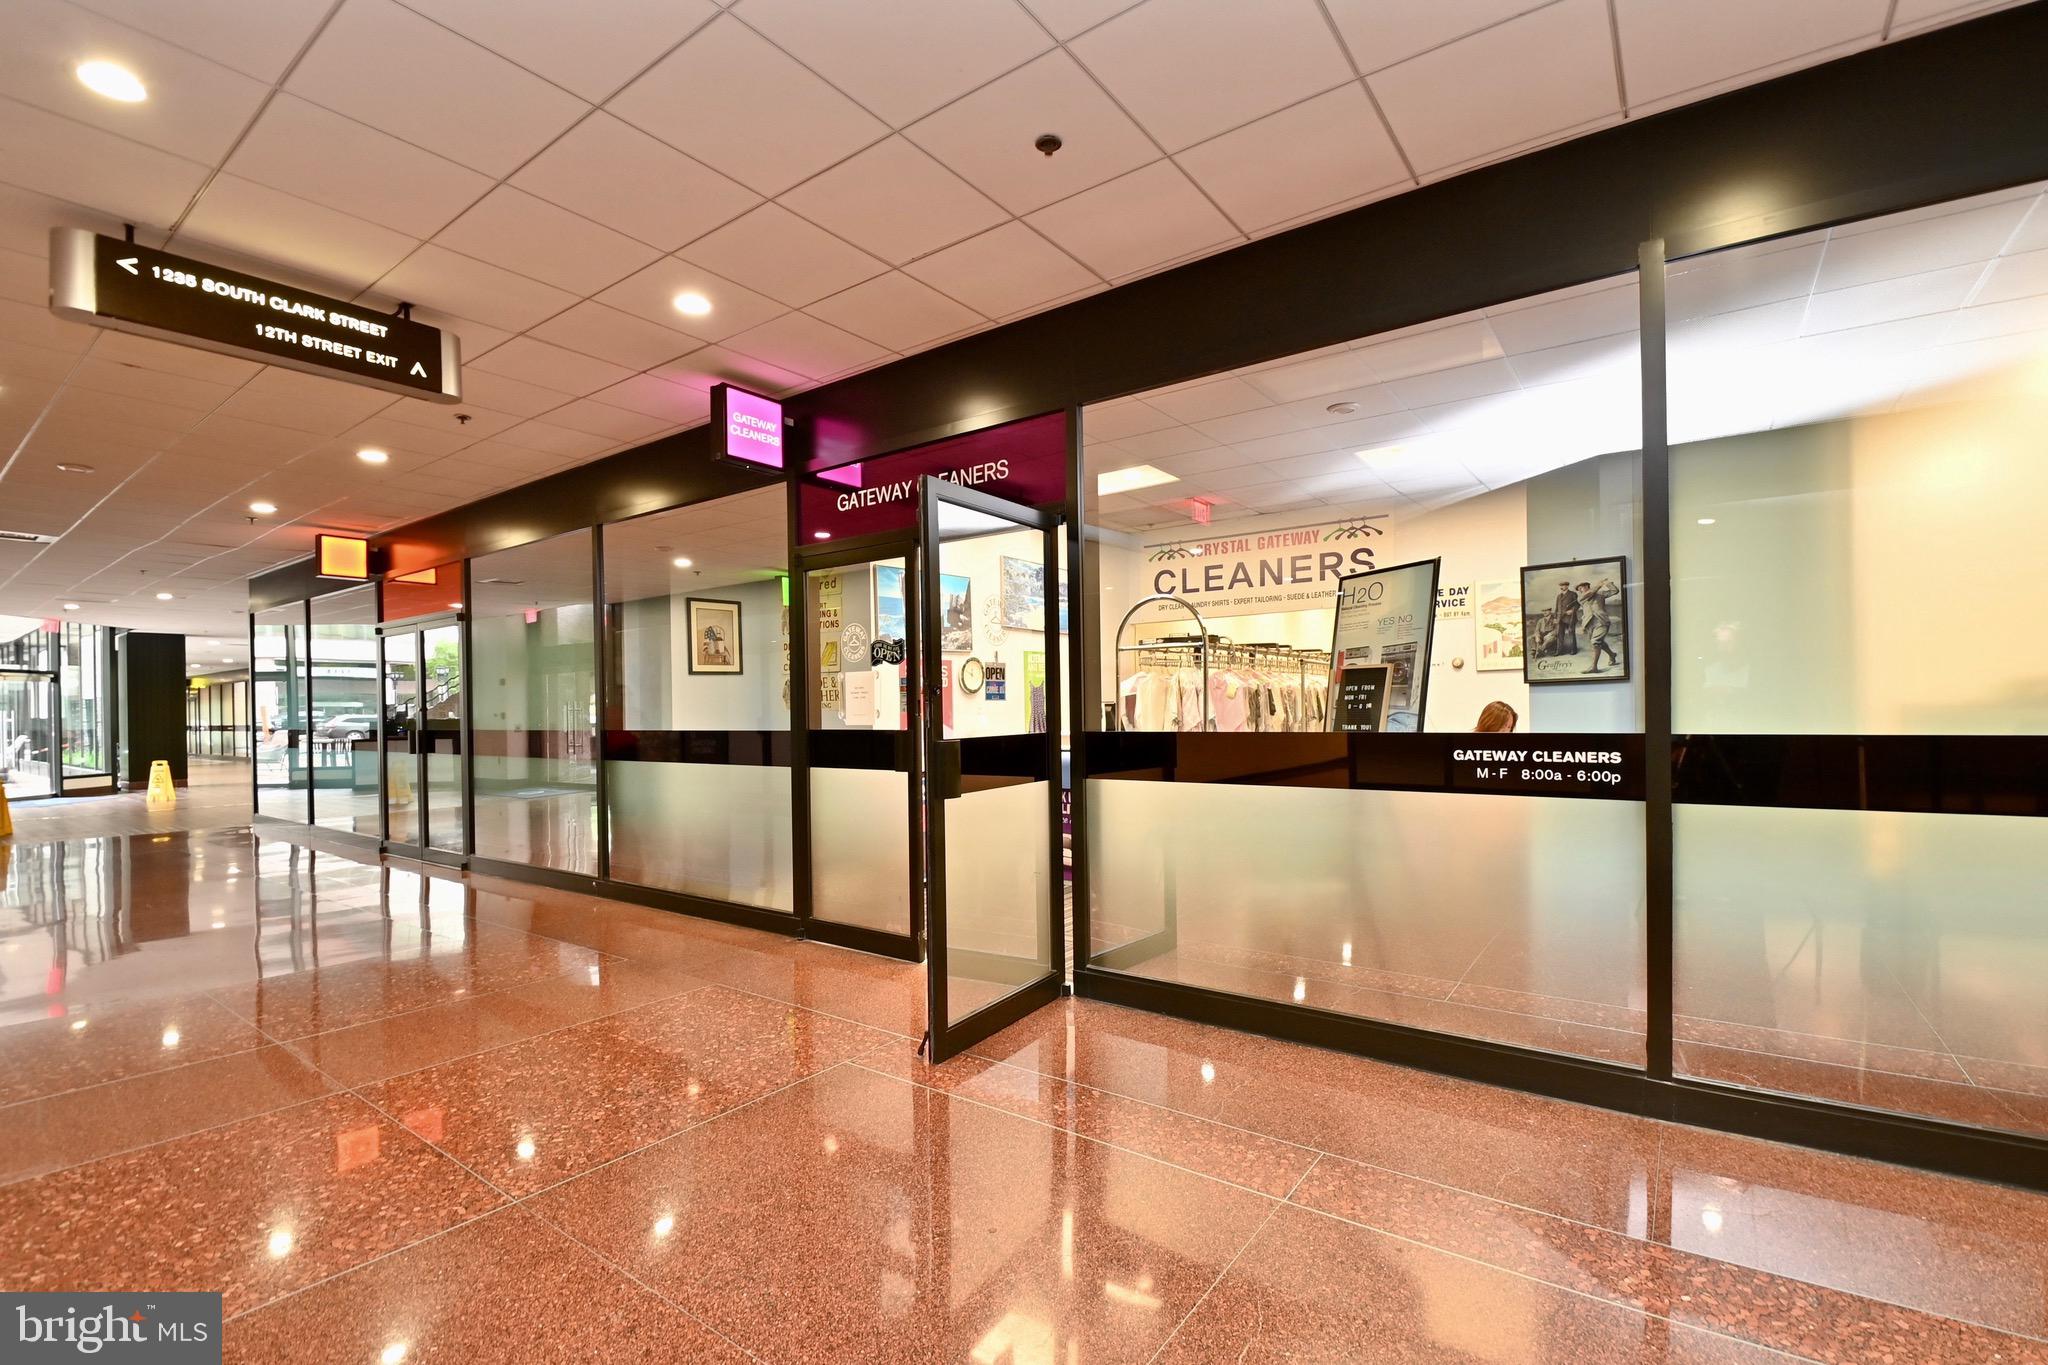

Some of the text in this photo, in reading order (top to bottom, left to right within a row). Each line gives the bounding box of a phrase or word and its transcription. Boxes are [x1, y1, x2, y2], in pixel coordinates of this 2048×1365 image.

[152, 266, 388, 338] 1235 SOUTH CLARK STREET
[255, 323, 399, 368] 12TH STREET EXIT
[733, 412, 776, 432] GATEWAY
[730, 424, 780, 446] CLEANERS
[837, 480, 912, 512] GATEWAY
[1257, 530, 1320, 550] GATEWAY
[1154, 547, 1376, 595] CLEANERS
[1341, 581, 1384, 606] H2O
[1449, 586, 1469, 596] DAY
[1158, 604, 1168, 612] DRY
[1211, 598, 1230, 607] SHIRTS
[1234, 597, 1253, 605] EXPERT
[1254, 594, 1283, 604] TAILORING
[1287, 592, 1305, 601] SUEDE
[1377, 616, 1395, 626] YES
[1398, 614, 1413, 624] NO
[873, 647, 901, 661] OPEN
[985, 667, 1005, 680] OPEN
[1453, 749, 1622, 764] GATEWAY CLEANERS
[1521, 769, 1562, 781] 8:00a
[1576, 770, 1621, 785] 6:00p
